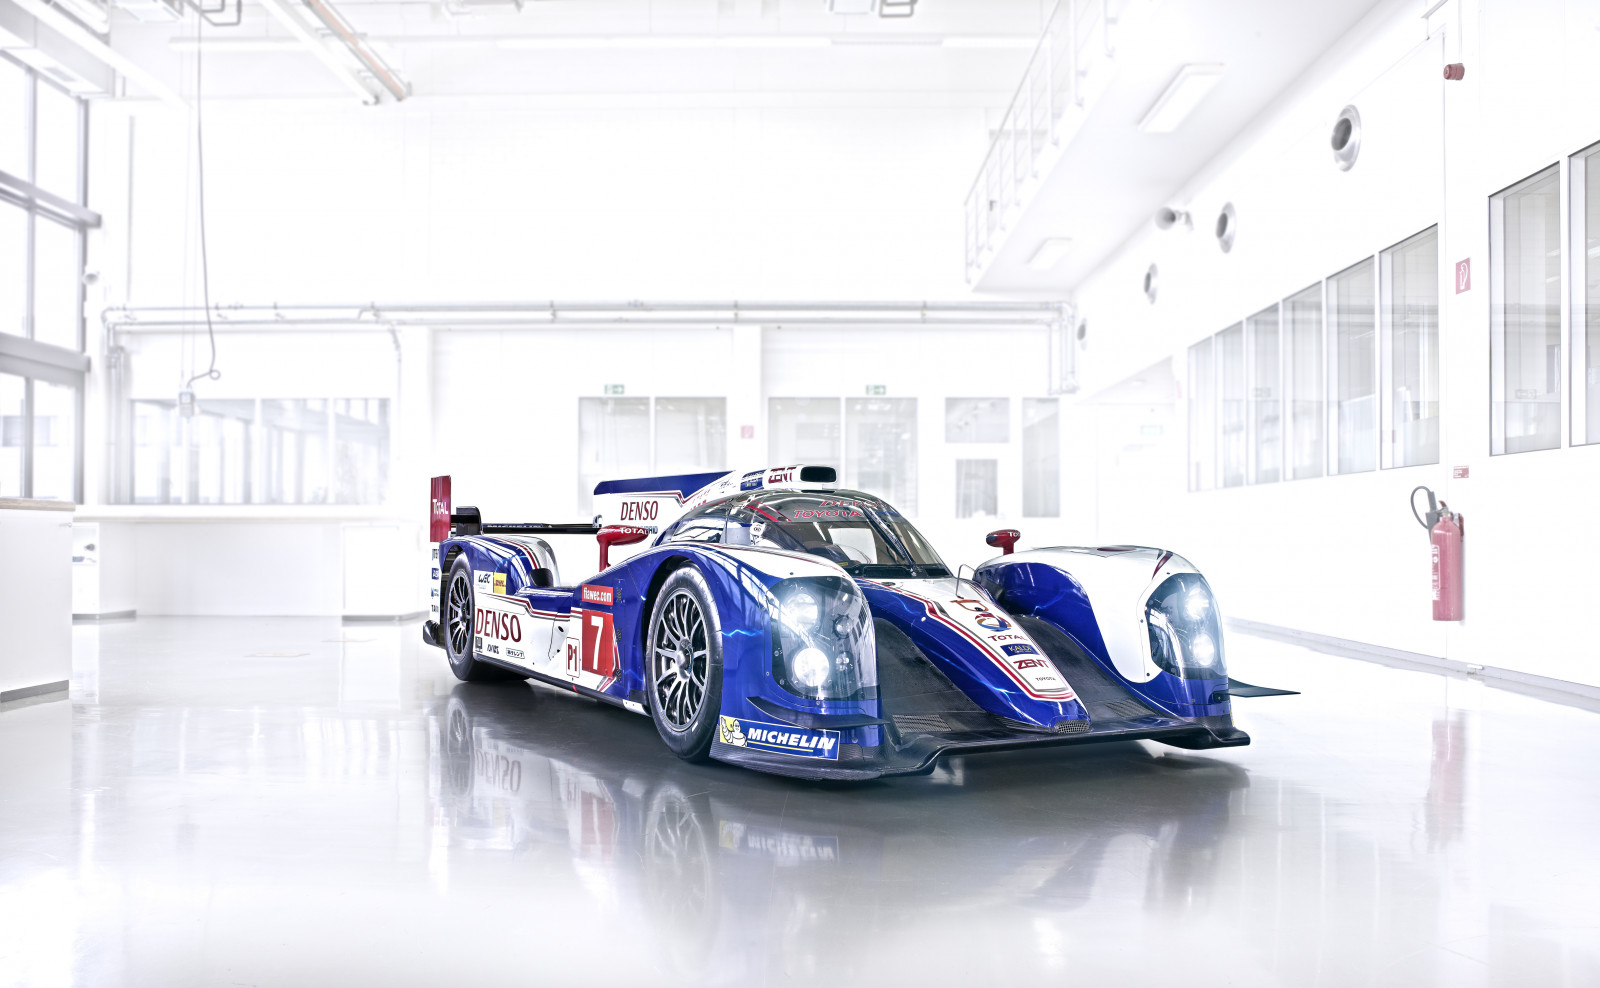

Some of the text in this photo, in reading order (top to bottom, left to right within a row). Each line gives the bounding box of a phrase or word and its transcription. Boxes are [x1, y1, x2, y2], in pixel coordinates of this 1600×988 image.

[768, 466, 797, 484] ZENT
[620, 501, 659, 521] DENSO
[794, 510, 863, 519] TOYOTA
[619, 527, 649, 535] TOTAL
[583, 587, 612, 603] fiawec.com
[475, 608, 522, 643] DENSO
[591, 615, 604, 670] 7
[567, 644, 578, 672] P1
[1013, 659, 1049, 670] ZENT
[747, 727, 836, 750] MICHELIN
